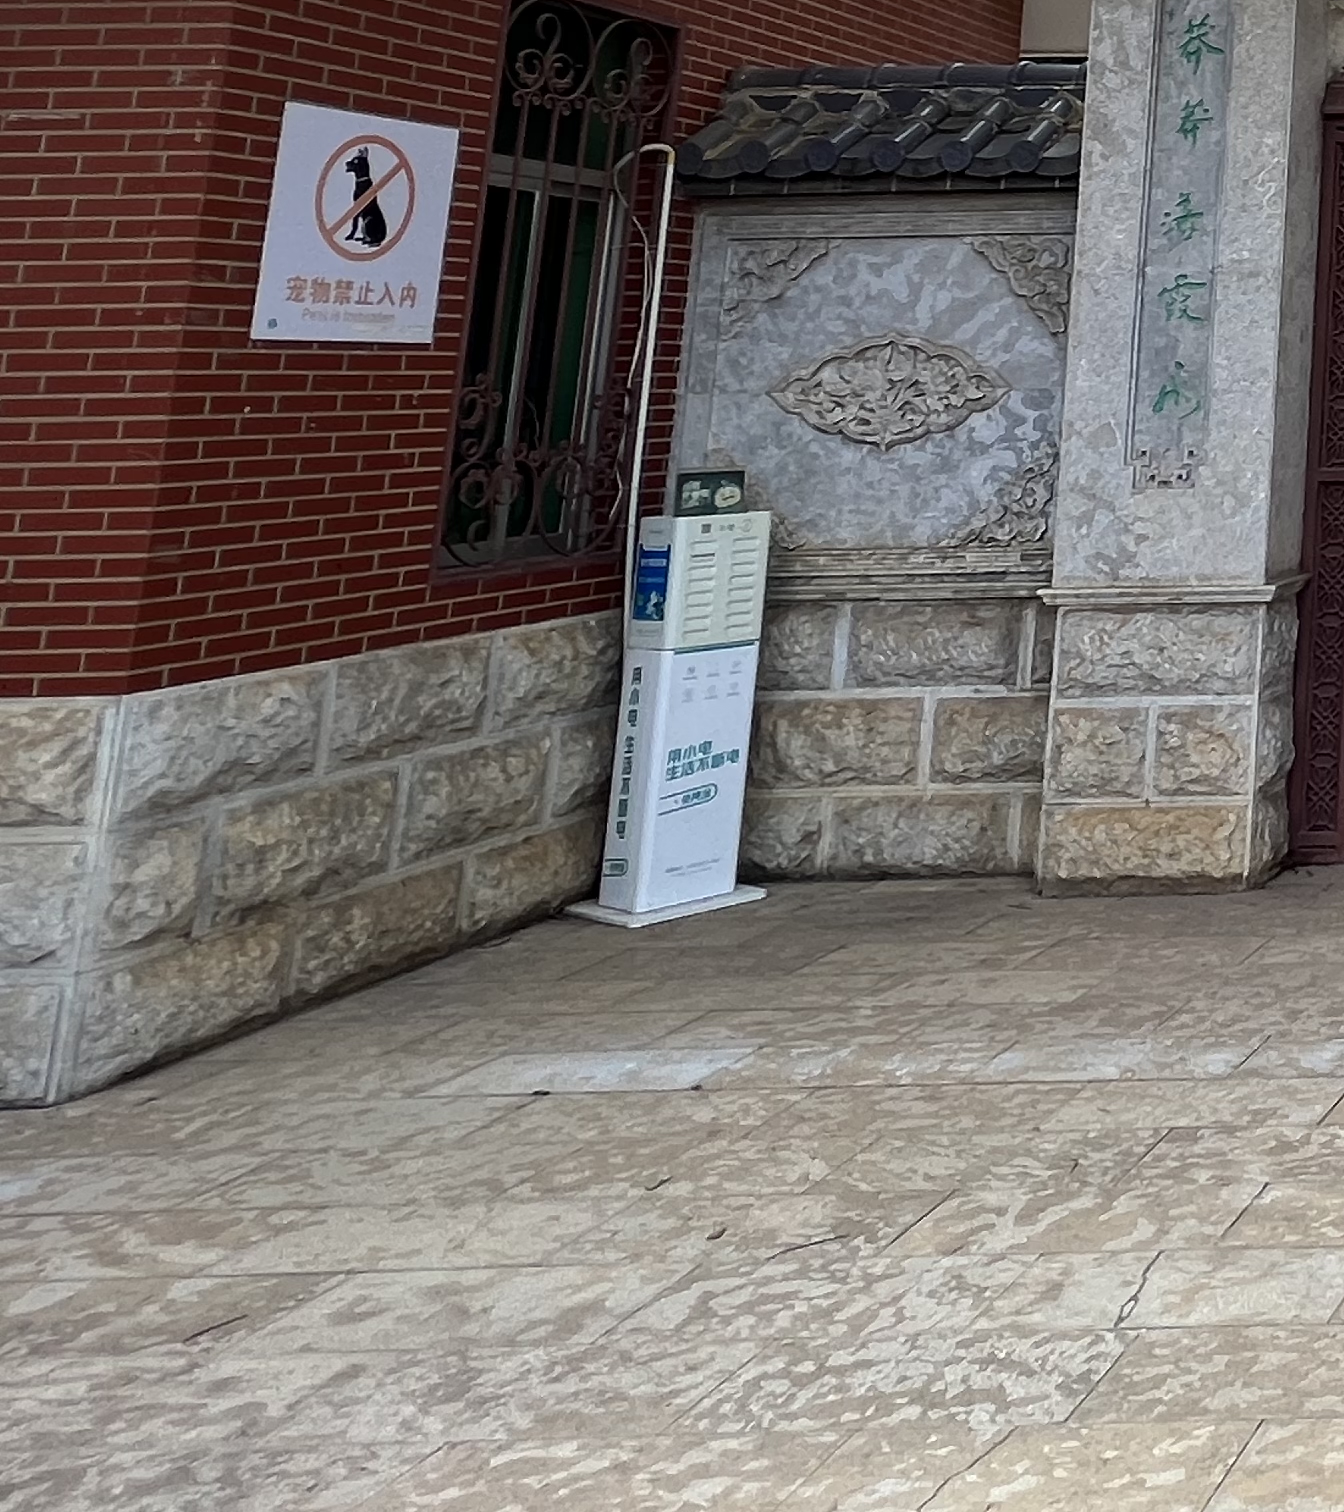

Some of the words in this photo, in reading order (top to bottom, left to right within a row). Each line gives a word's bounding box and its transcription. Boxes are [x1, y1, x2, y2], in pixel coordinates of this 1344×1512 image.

[285, 275, 418, 309] 宠物禁止入内
